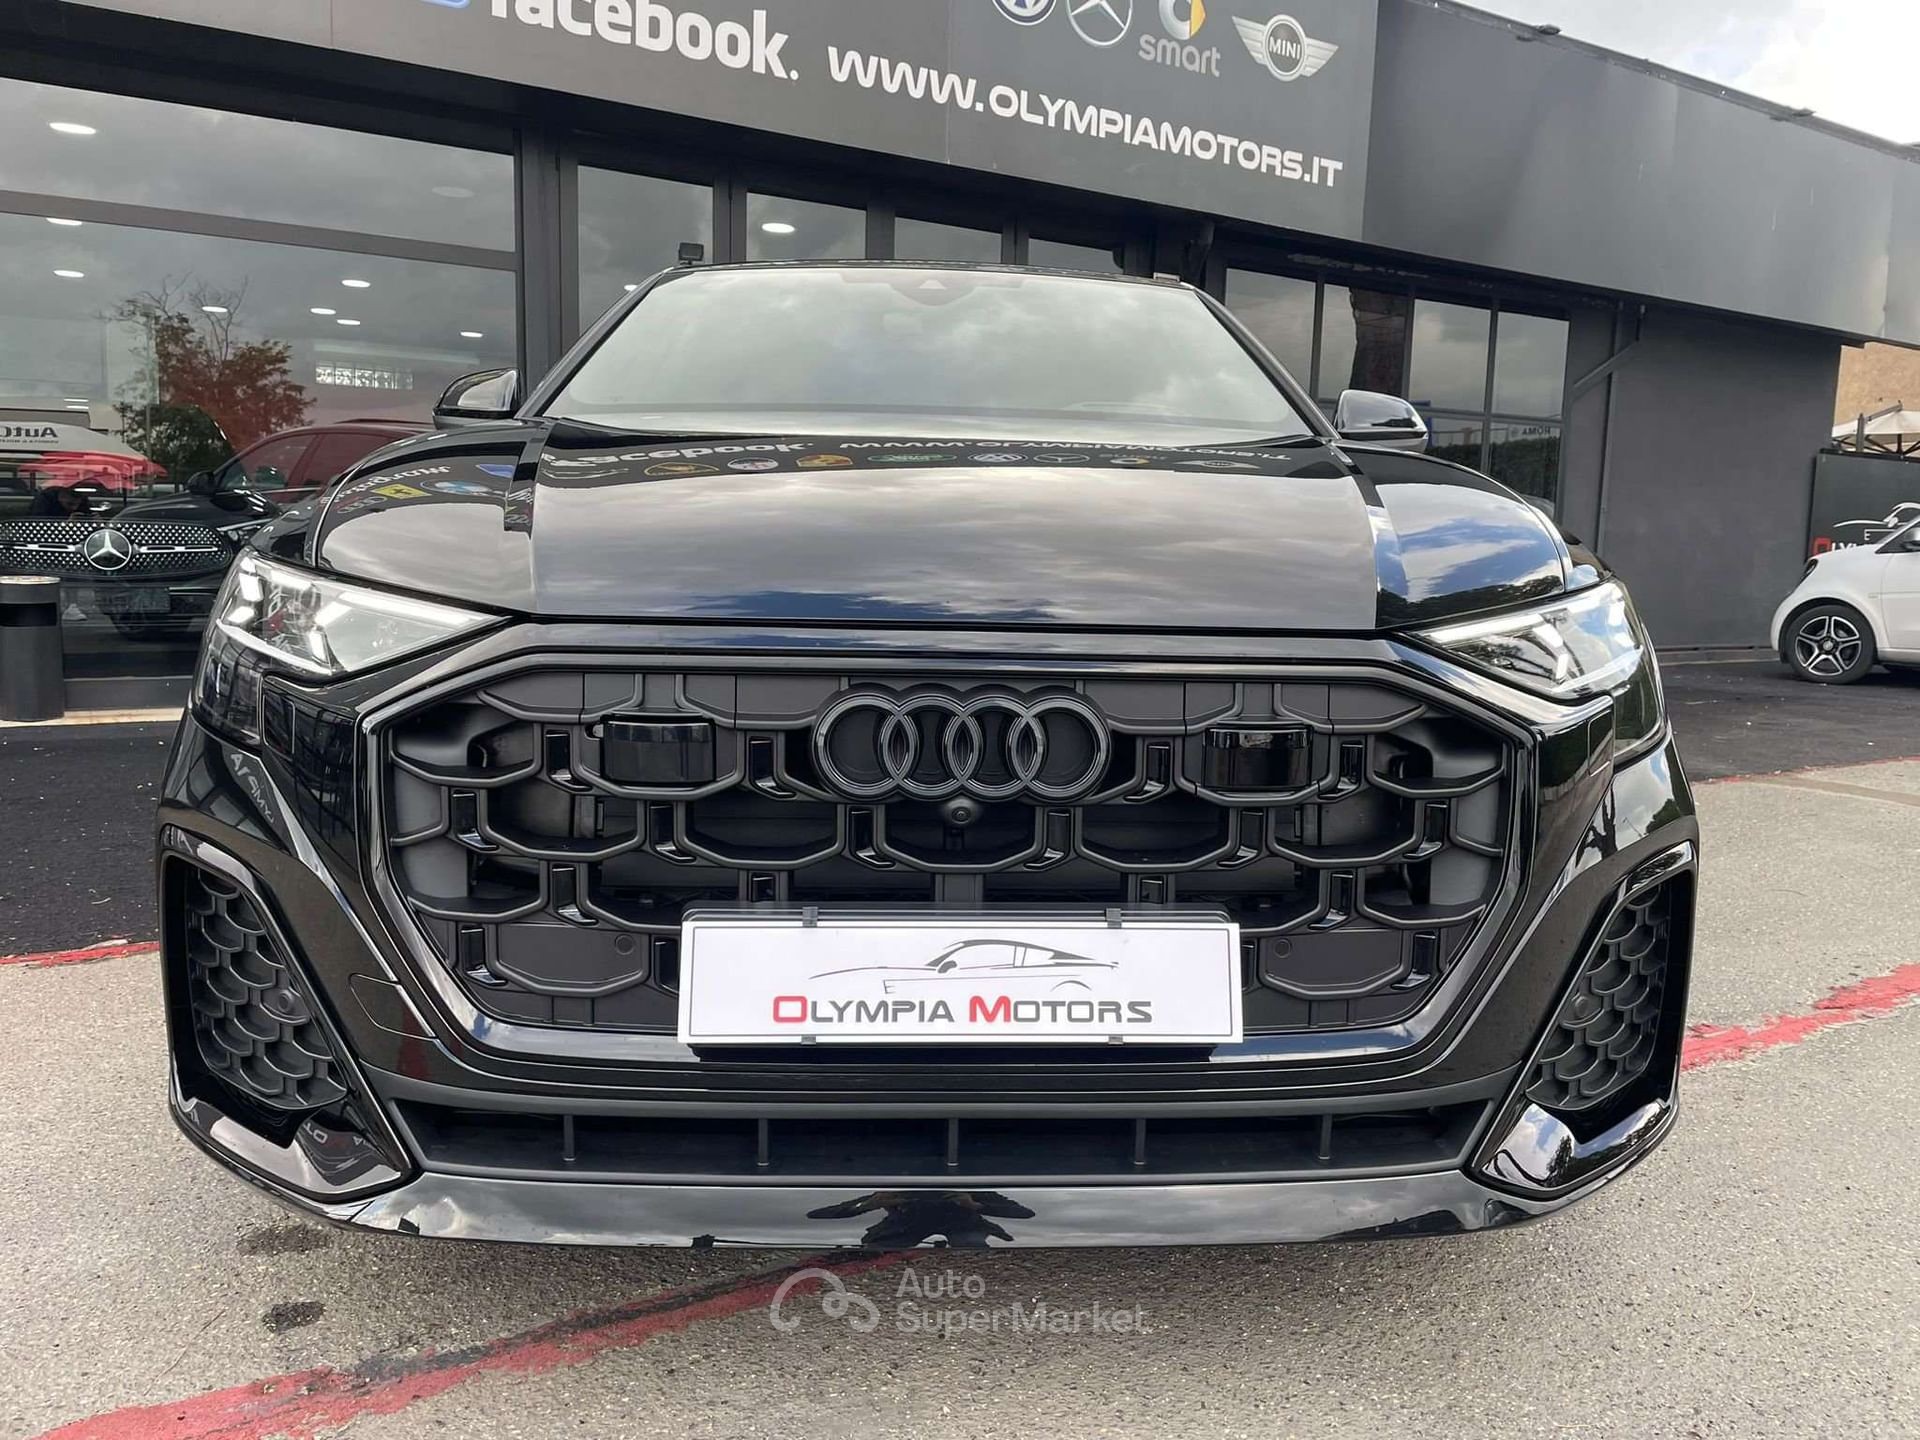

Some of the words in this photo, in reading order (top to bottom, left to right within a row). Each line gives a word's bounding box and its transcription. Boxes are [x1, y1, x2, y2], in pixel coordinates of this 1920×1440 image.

[1138, 34, 1221, 78] smart
[1269, 35, 1301, 61] MINI
[772, 995, 955, 1024] OLYMPIA
[968, 995, 1153, 1024] MOTORS
